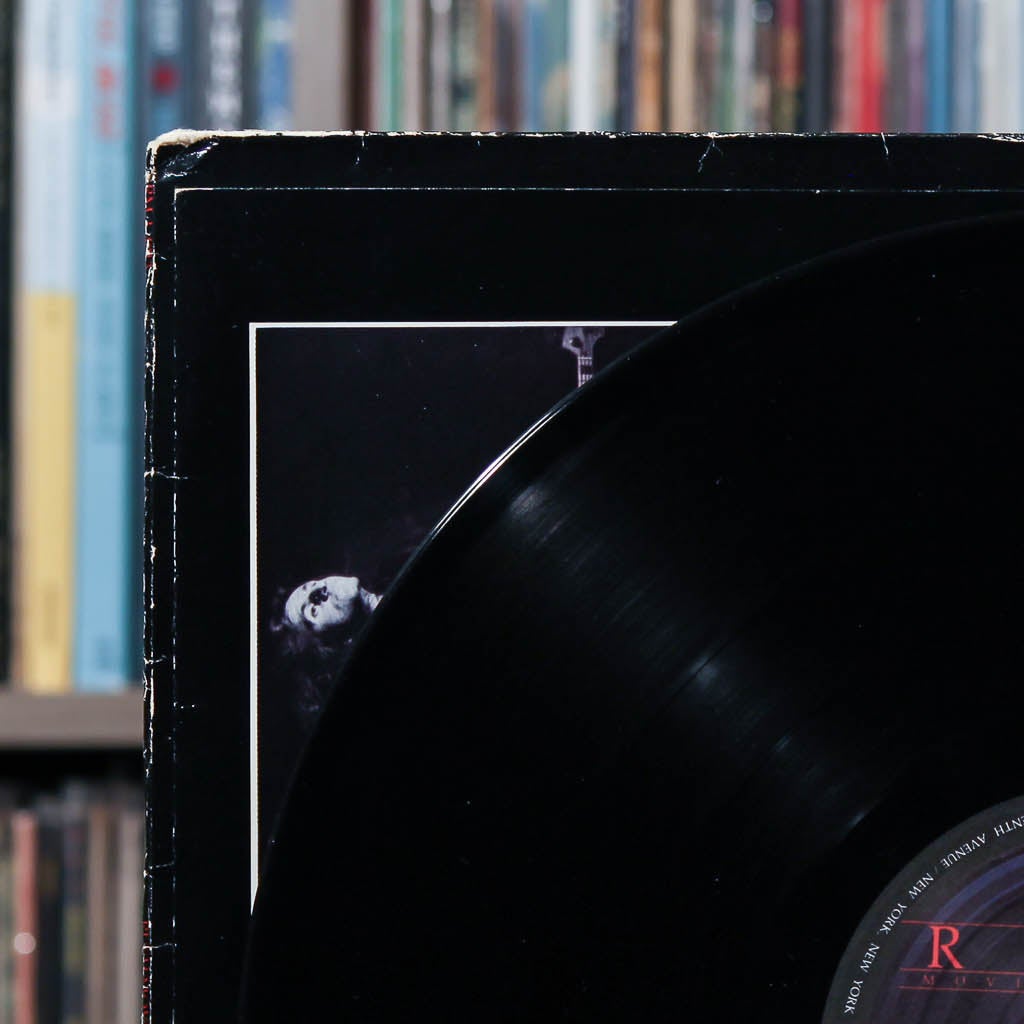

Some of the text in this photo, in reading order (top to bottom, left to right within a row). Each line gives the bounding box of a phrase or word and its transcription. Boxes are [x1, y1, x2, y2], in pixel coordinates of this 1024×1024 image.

[939, 832, 986, 869] AVENUE
[908, 872, 935, 900] NEW
[859, 942, 881, 973] NEW
[843, 979, 864, 1015] YORK
